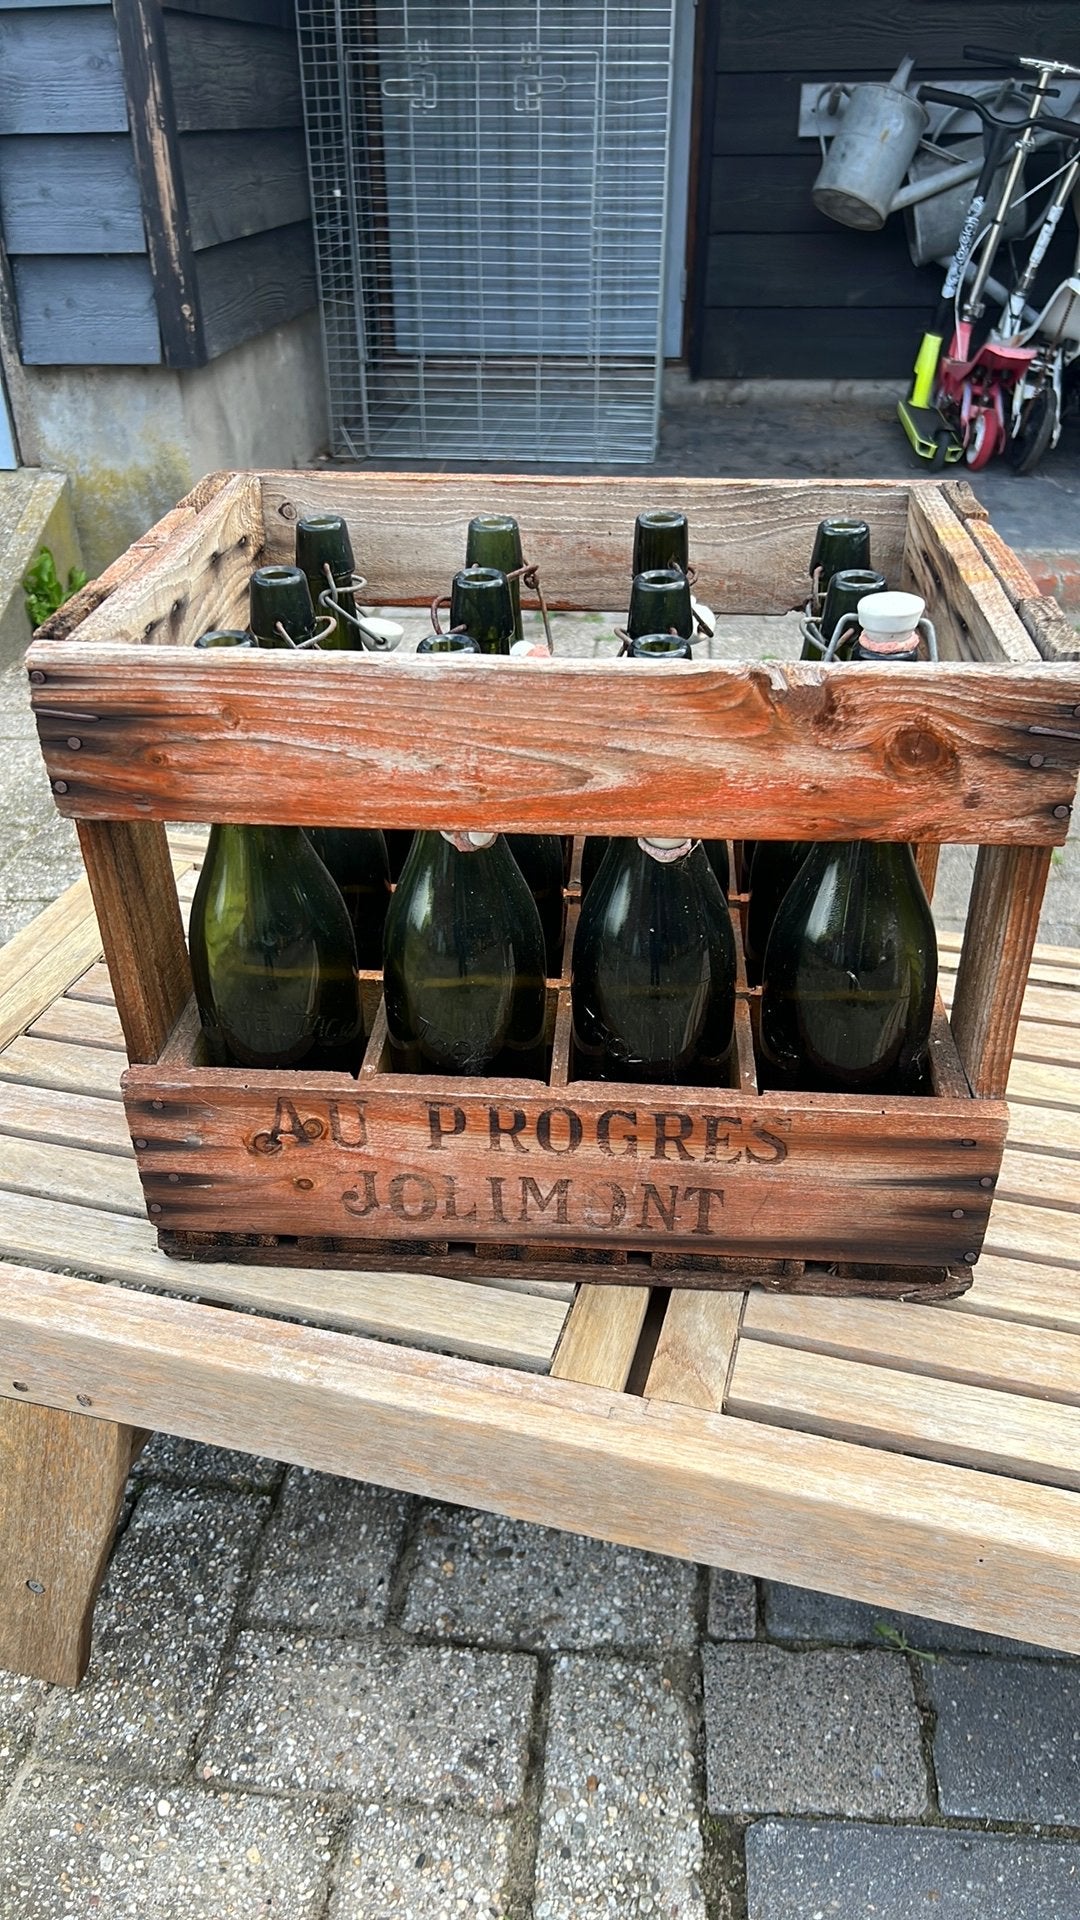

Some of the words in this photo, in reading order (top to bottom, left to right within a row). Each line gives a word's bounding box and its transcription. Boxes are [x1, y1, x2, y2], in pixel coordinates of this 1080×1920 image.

[269, 1097, 368, 1148] AU
[424, 1101, 792, 1165] PROGRES
[341, 1171, 726, 1236] JOLIMONT
